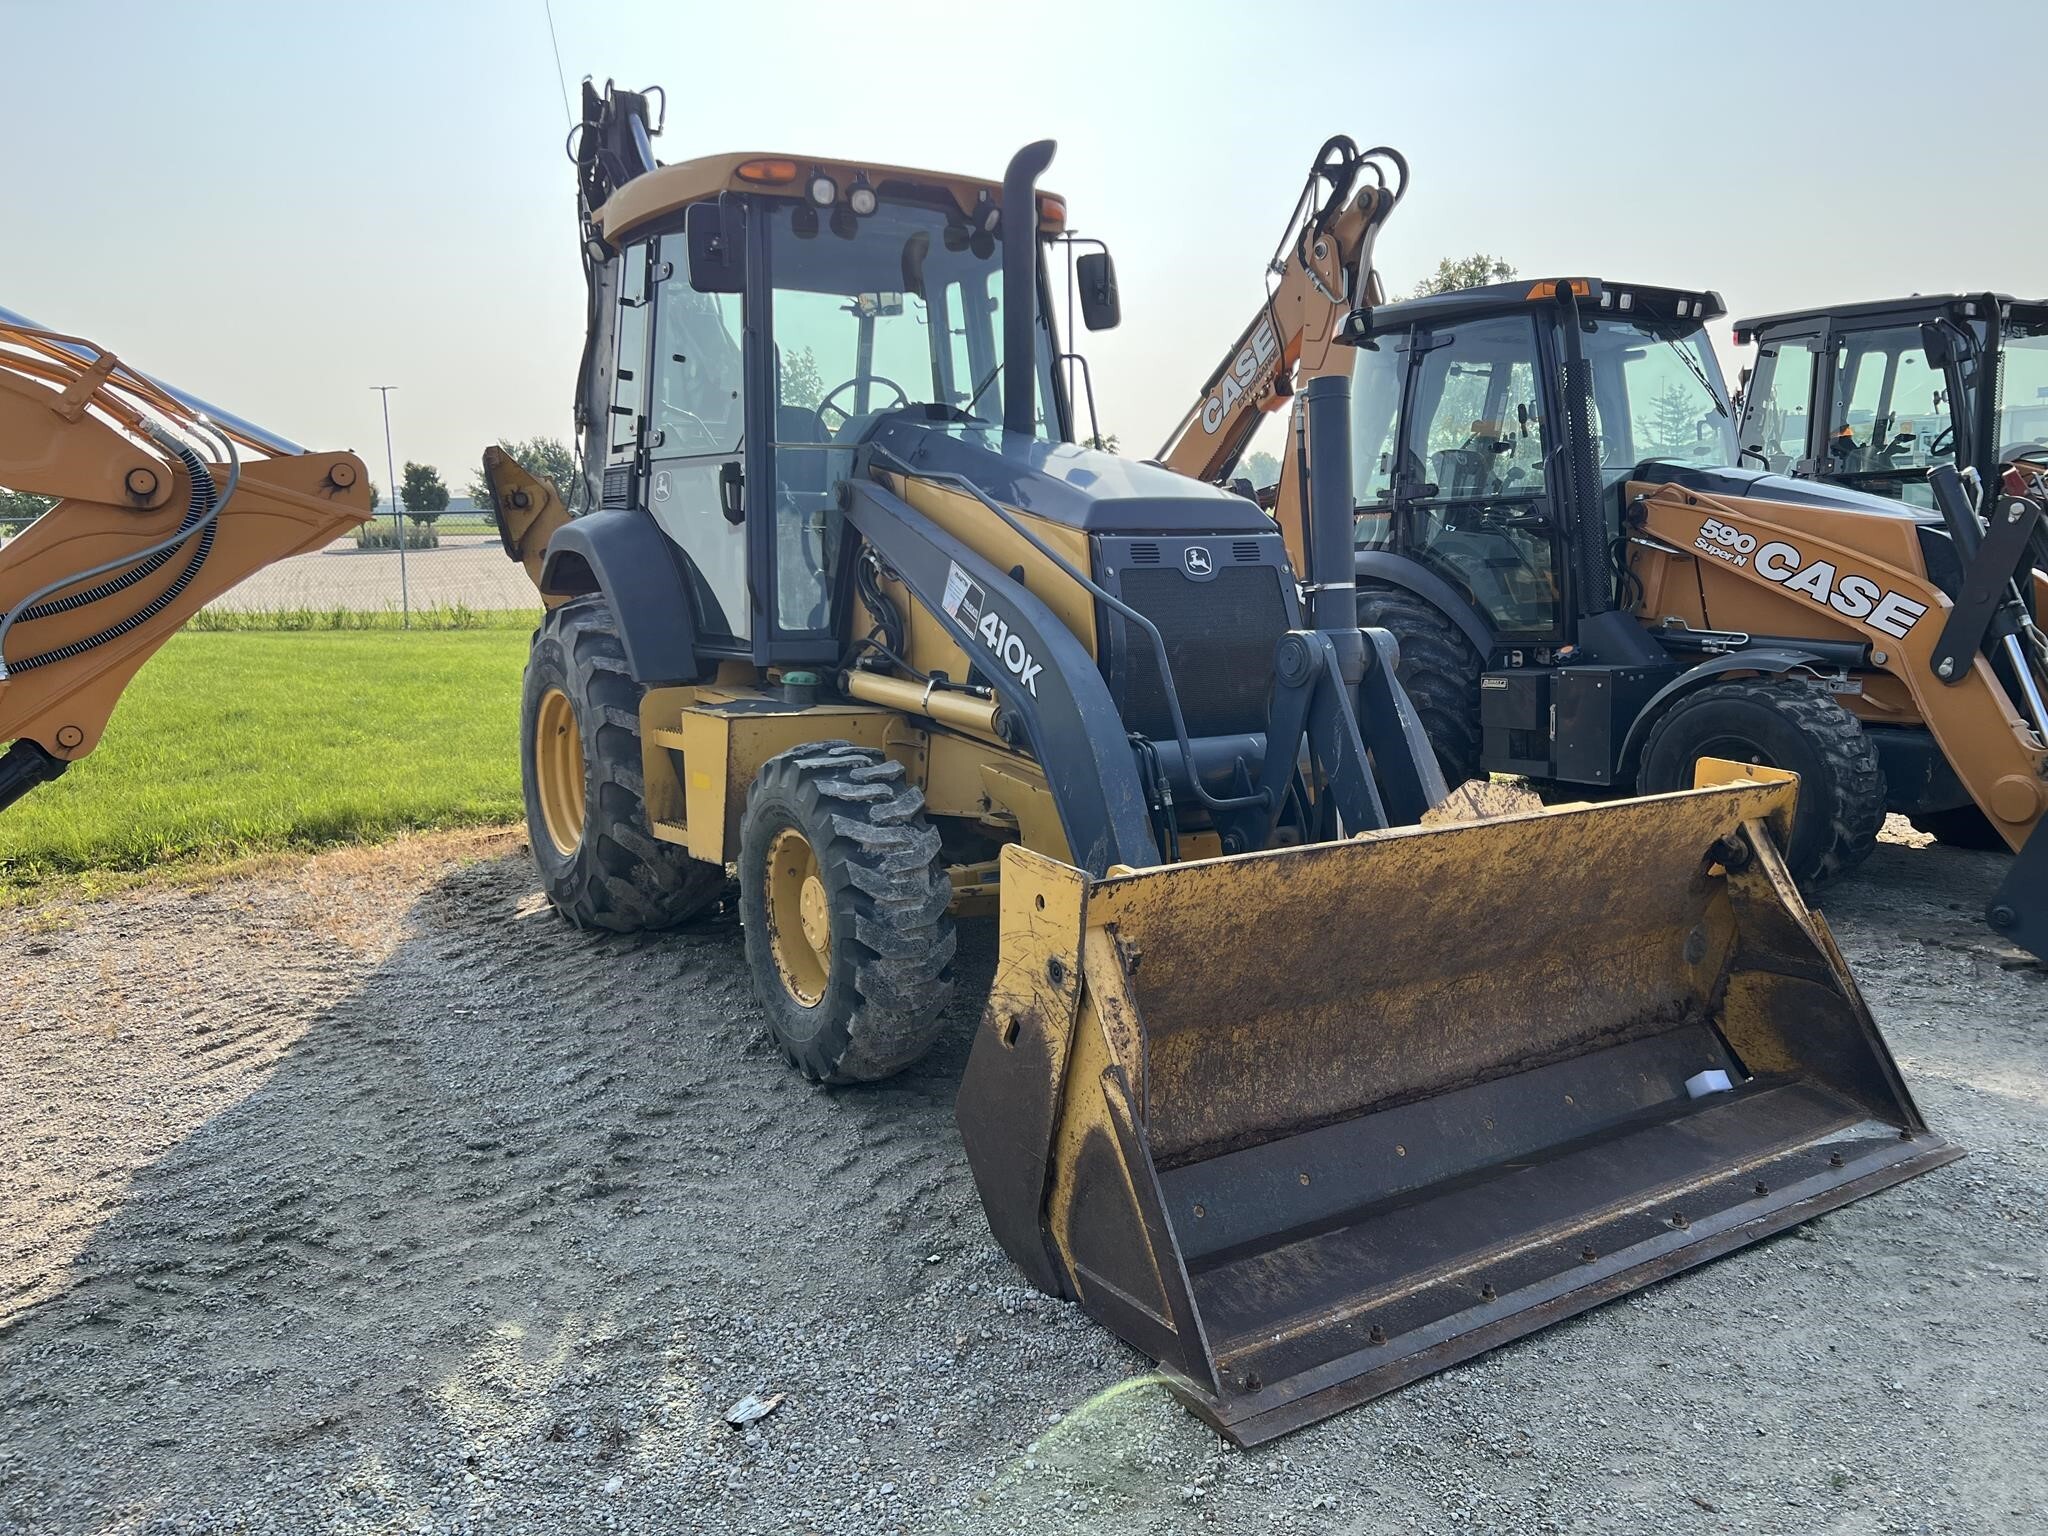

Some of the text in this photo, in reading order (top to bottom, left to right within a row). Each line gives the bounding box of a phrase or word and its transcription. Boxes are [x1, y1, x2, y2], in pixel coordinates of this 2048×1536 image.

[1202, 319, 1276, 434] CASE
[1694, 537, 1748, 567] Super N
[1700, 517, 1757, 554] 590
[1754, 541, 1928, 640] CASE
[979, 612, 1043, 699] 410K
